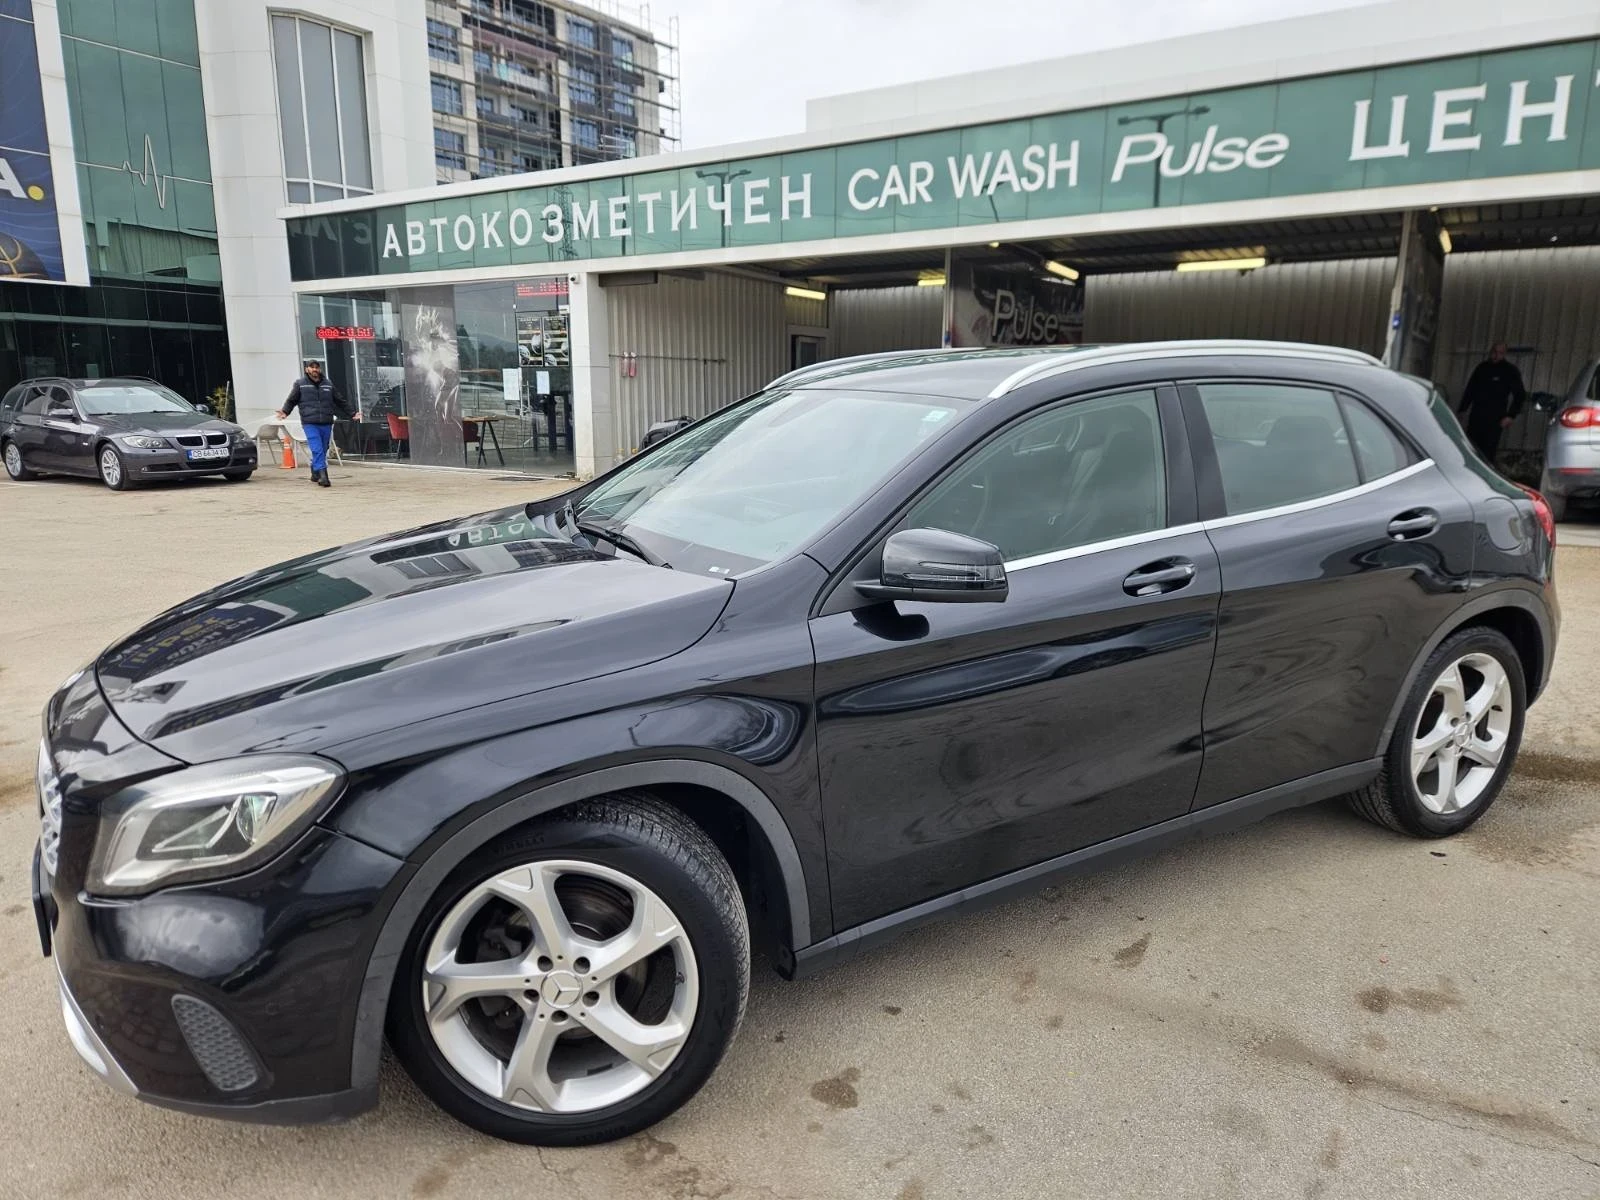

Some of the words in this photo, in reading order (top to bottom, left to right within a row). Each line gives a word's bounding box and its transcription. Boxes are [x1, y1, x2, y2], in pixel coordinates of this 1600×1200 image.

[382, 173, 812, 258] АВТОКОЗМЕТИЧЕН
[848, 160, 934, 211] CAR
[947, 140, 1080, 200] WASH
[1111, 125, 1290, 183] Pulse
[1348, 69, 1600, 161] ЦЕН
[992, 289, 1059, 343] Pulse
